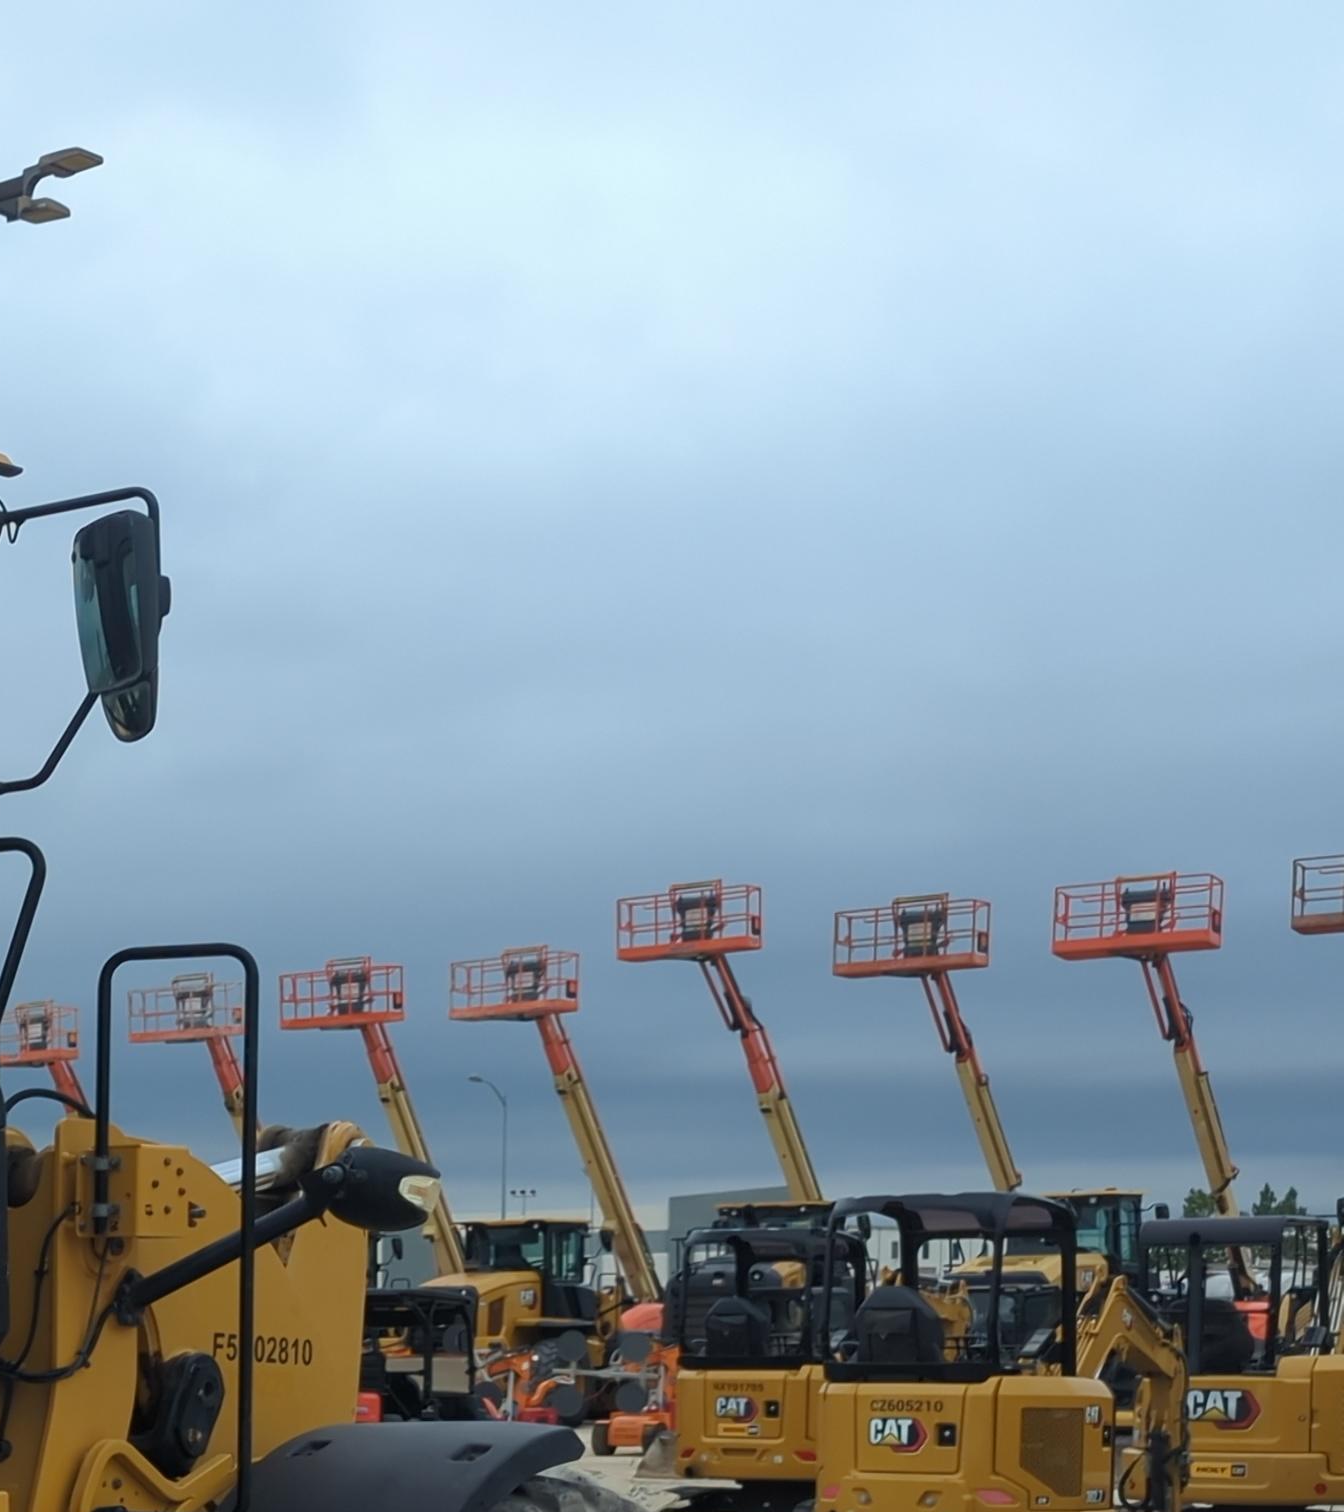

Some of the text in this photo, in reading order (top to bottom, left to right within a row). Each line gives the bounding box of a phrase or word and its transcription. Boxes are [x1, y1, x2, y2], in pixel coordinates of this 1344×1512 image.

[213, 1332, 312, 1366] F502810
[715, 1397, 748, 1417] CAT
[870, 1400, 943, 1412] CZ605210
[1186, 1390, 1243, 1421] CAT
[869, 1418, 912, 1445] CAT
